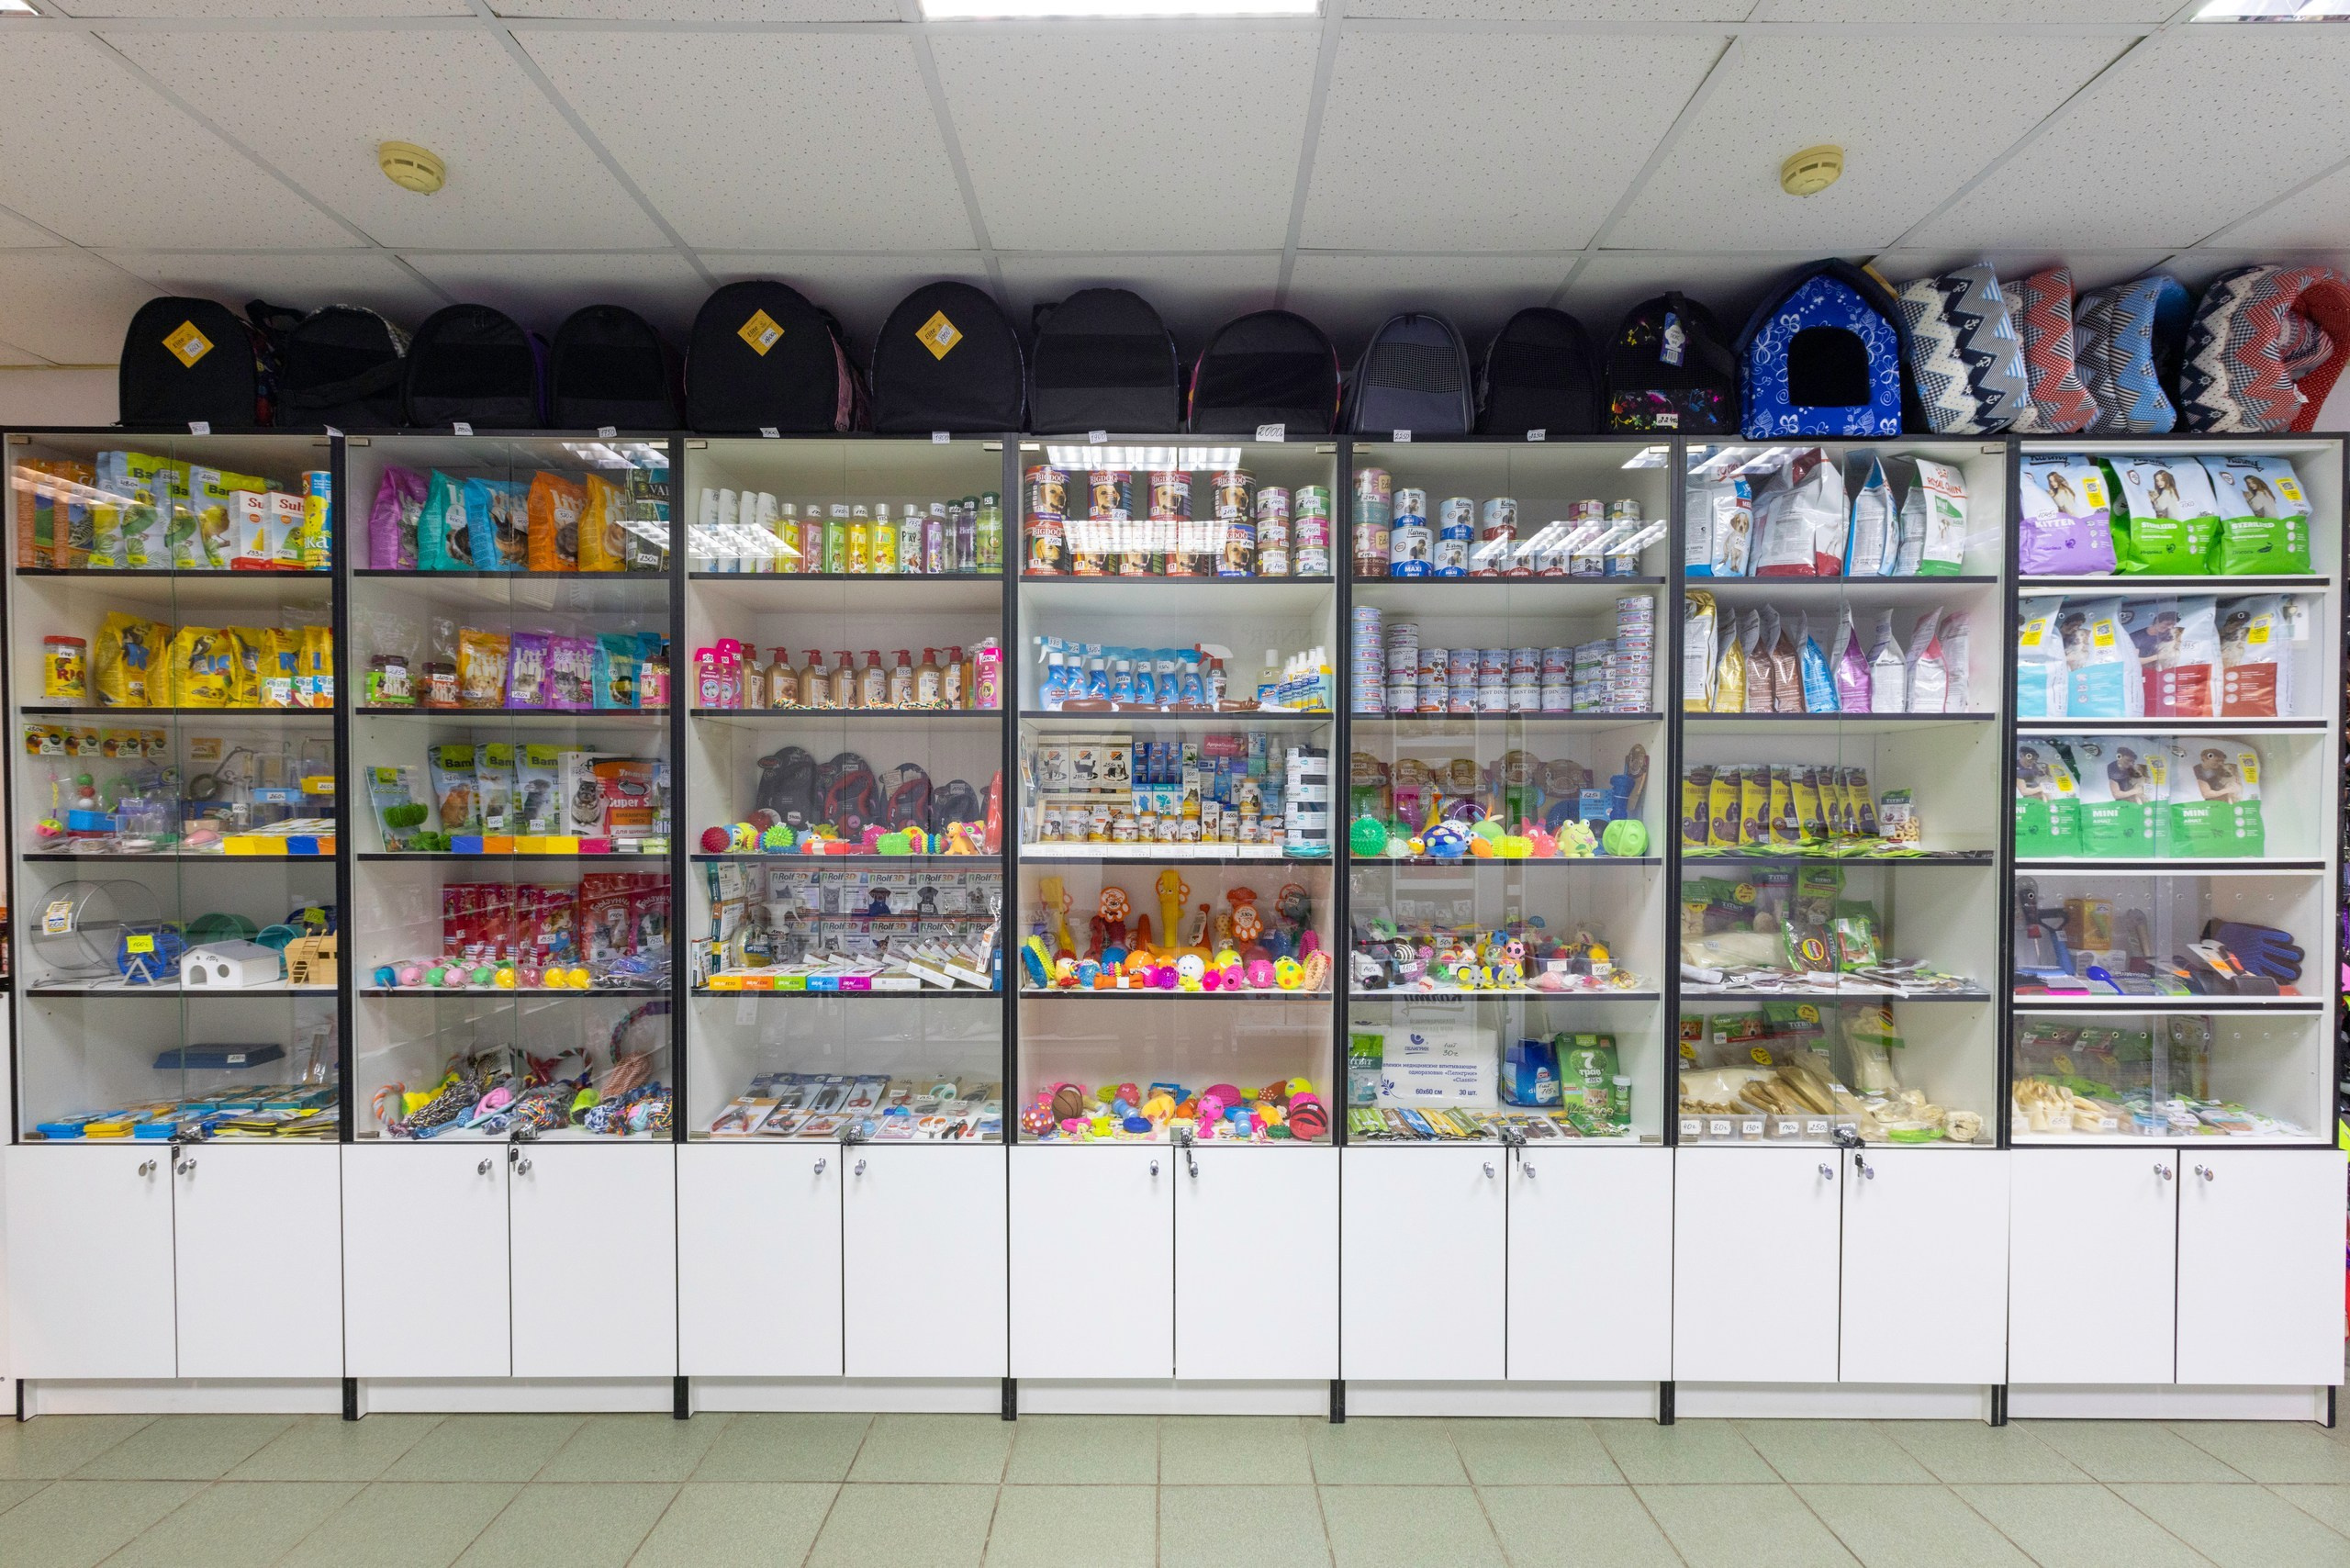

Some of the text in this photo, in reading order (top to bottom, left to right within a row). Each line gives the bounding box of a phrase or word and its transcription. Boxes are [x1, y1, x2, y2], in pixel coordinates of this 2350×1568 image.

[1035, 472, 1065, 484] BIGDOG
[2035, 519, 2076, 529] KITTEN
[1031, 527, 1062, 537] BIGDOG
[1406, 528, 1428, 540] Karmy
[2092, 810, 2119, 818] MINI
[2183, 809, 2210, 818] MINI
[876, 874, 893, 883] Rolf
[924, 874, 943, 883] Rolf
[878, 922, 895, 931] Rolf
[1581, 1051, 1595, 1070] 7
[1578, 1069, 1601, 1077] трав
